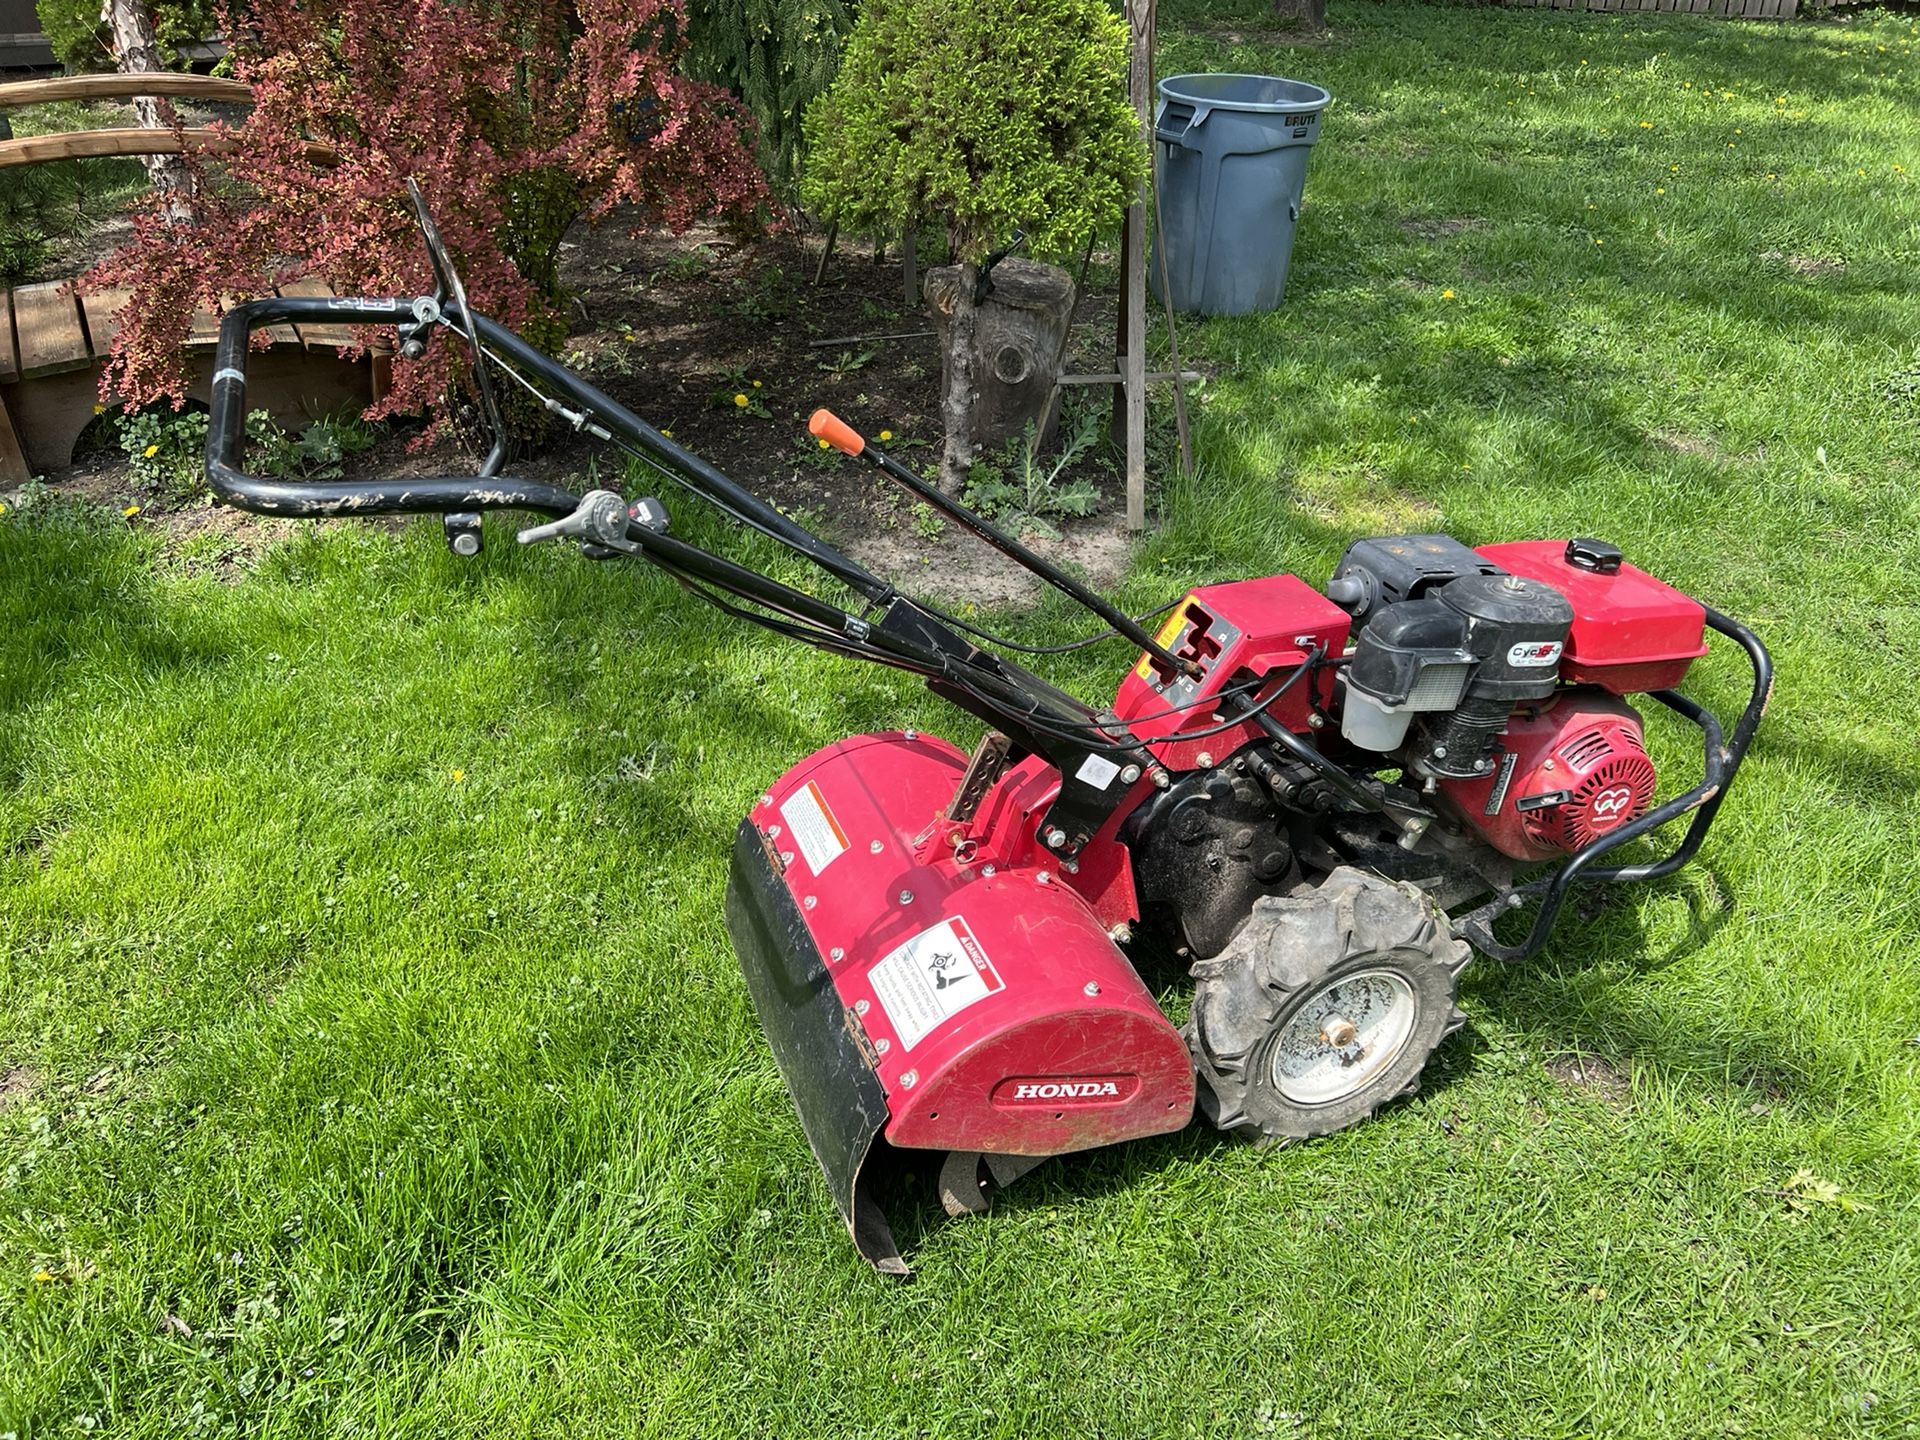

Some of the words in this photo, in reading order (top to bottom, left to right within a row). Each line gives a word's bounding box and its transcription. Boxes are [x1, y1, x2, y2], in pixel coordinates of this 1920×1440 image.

[1284, 114, 1316, 127] BRUTE
[1218, 633, 1227, 642] R
[1155, 685, 1163, 693] 2
[1185, 684, 1194, 692] 3
[964, 942, 987, 971] DANGER
[1014, 1083, 1119, 1099] HONDA
